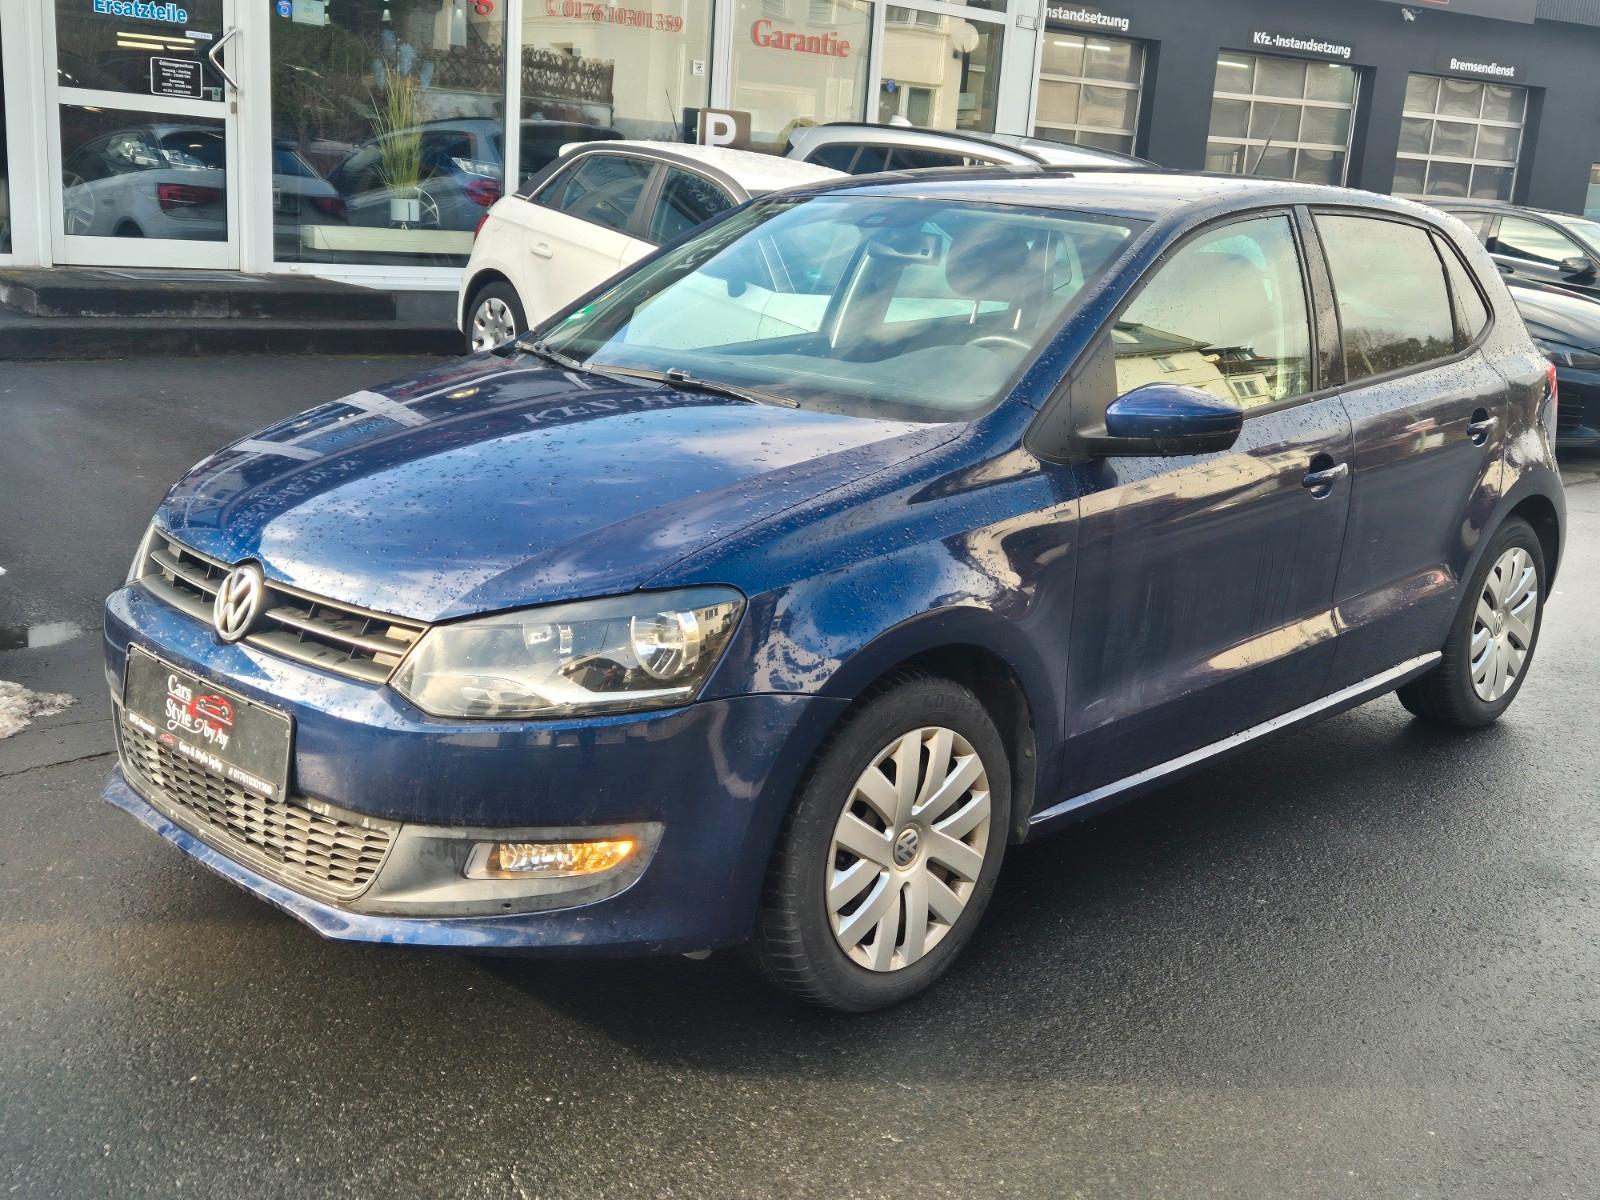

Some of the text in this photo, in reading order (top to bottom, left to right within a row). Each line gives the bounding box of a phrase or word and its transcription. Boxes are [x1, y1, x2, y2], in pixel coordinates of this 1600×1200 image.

[93, 0, 188, 24] Ersatzteile
[752, 18, 851, 58] Garantie
[1253, 31, 1351, 59] Kfz.-Instandsetzung
[1450, 58, 1515, 77] Bremsendienst
[705, 112, 737, 147] P
[168, 674, 192, 700] Cars
[166, 698, 193, 730] Style
